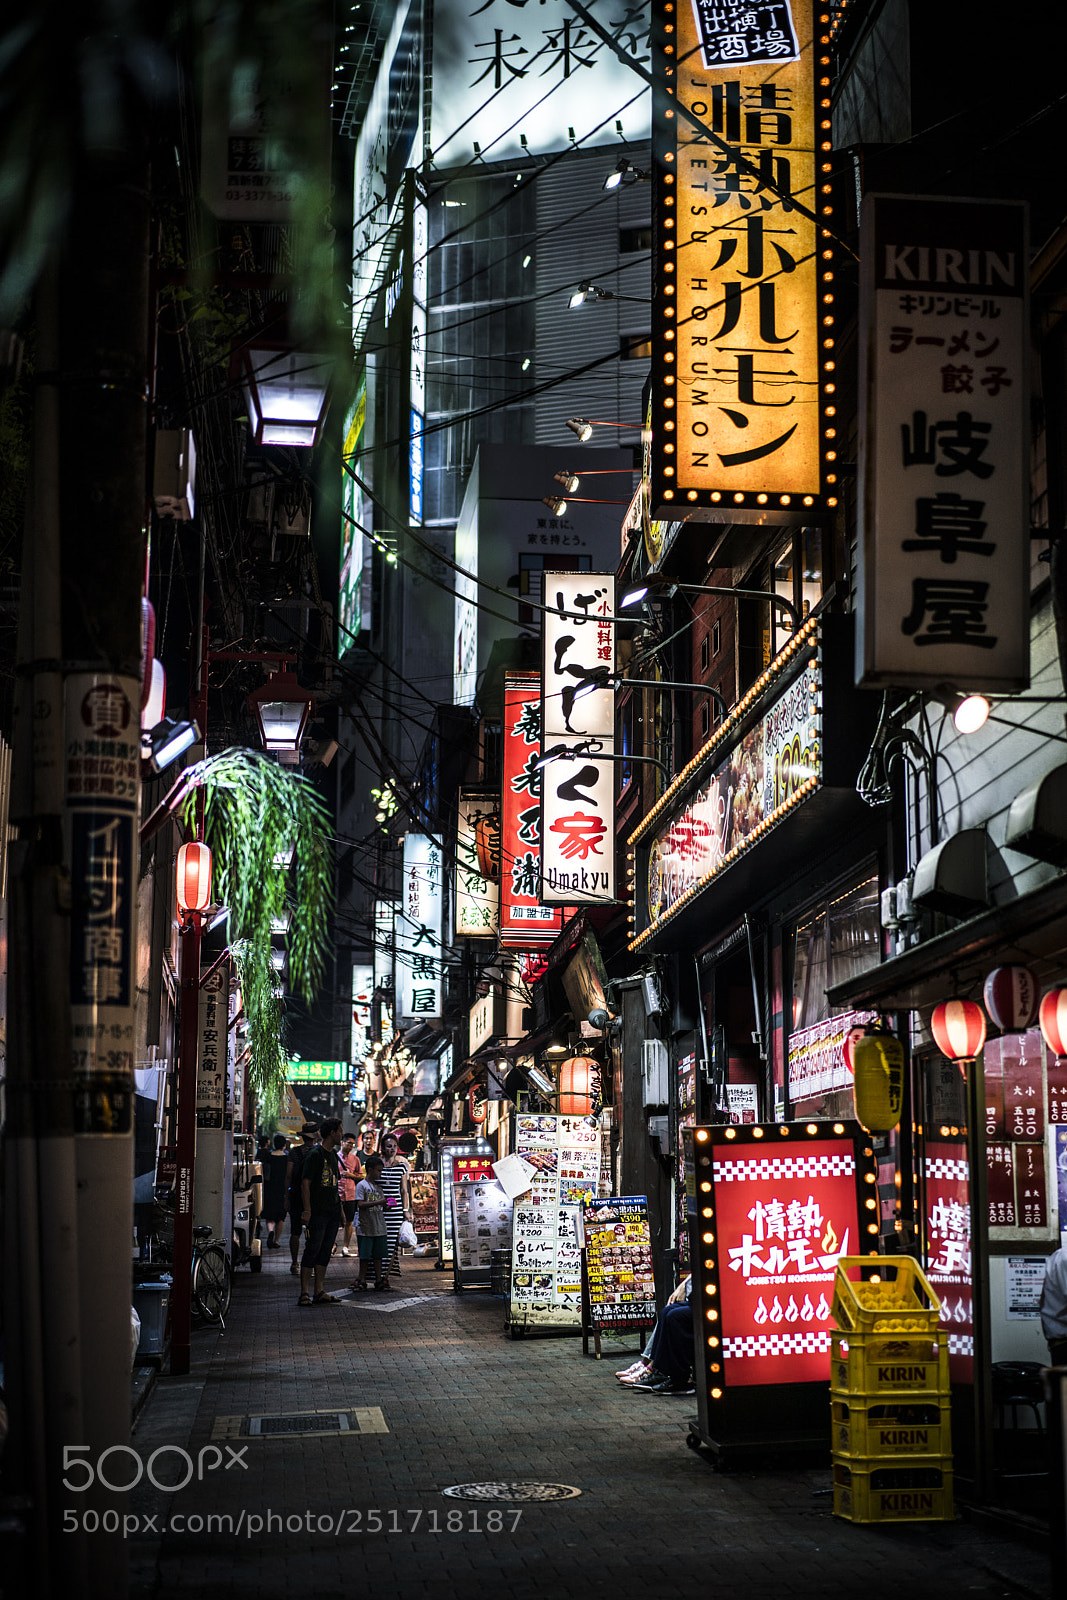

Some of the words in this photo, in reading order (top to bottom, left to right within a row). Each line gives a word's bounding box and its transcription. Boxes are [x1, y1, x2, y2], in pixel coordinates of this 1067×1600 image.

[707, 30, 791, 60] 酒場
[710, 81, 799, 468] 情熱ホルモン
[884, 244, 1016, 288] KIRIN
[899, 294, 1001, 319] キリンビール
[889, 326, 1000, 359] ラーメン
[691, 278, 709, 467] HORUMON
[940, 364, 1013, 397] 餃子
[527, 533, 587, 547] 家を持とう。
[901, 410, 998, 650] 岐阜屋
[548, 867, 610, 890] Umakyu
[512, 907, 553, 919] 加盟店
[411, 923, 437, 1013] 大黒屋
[203, 1030, 219, 1072] 安兵衛
[1013, 1085, 1023, 1096] 大
[1025, 1086, 1036, 1096] 小
[180, 1168, 187, 1179] NO
[1026, 1148, 1035, 1178] ラーメン
[747, 1195, 824, 1241] 情熱
[728, 1223, 849, 1278] ホルモン
[746, 1274, 787, 1286] JONETSU
[788, 1272, 835, 1284] HORUMON
[878, 1366, 927, 1382] KIRIN
[880, 1429, 929, 1445] KIRIN
[880, 1493, 933, 1511] KIRIN
